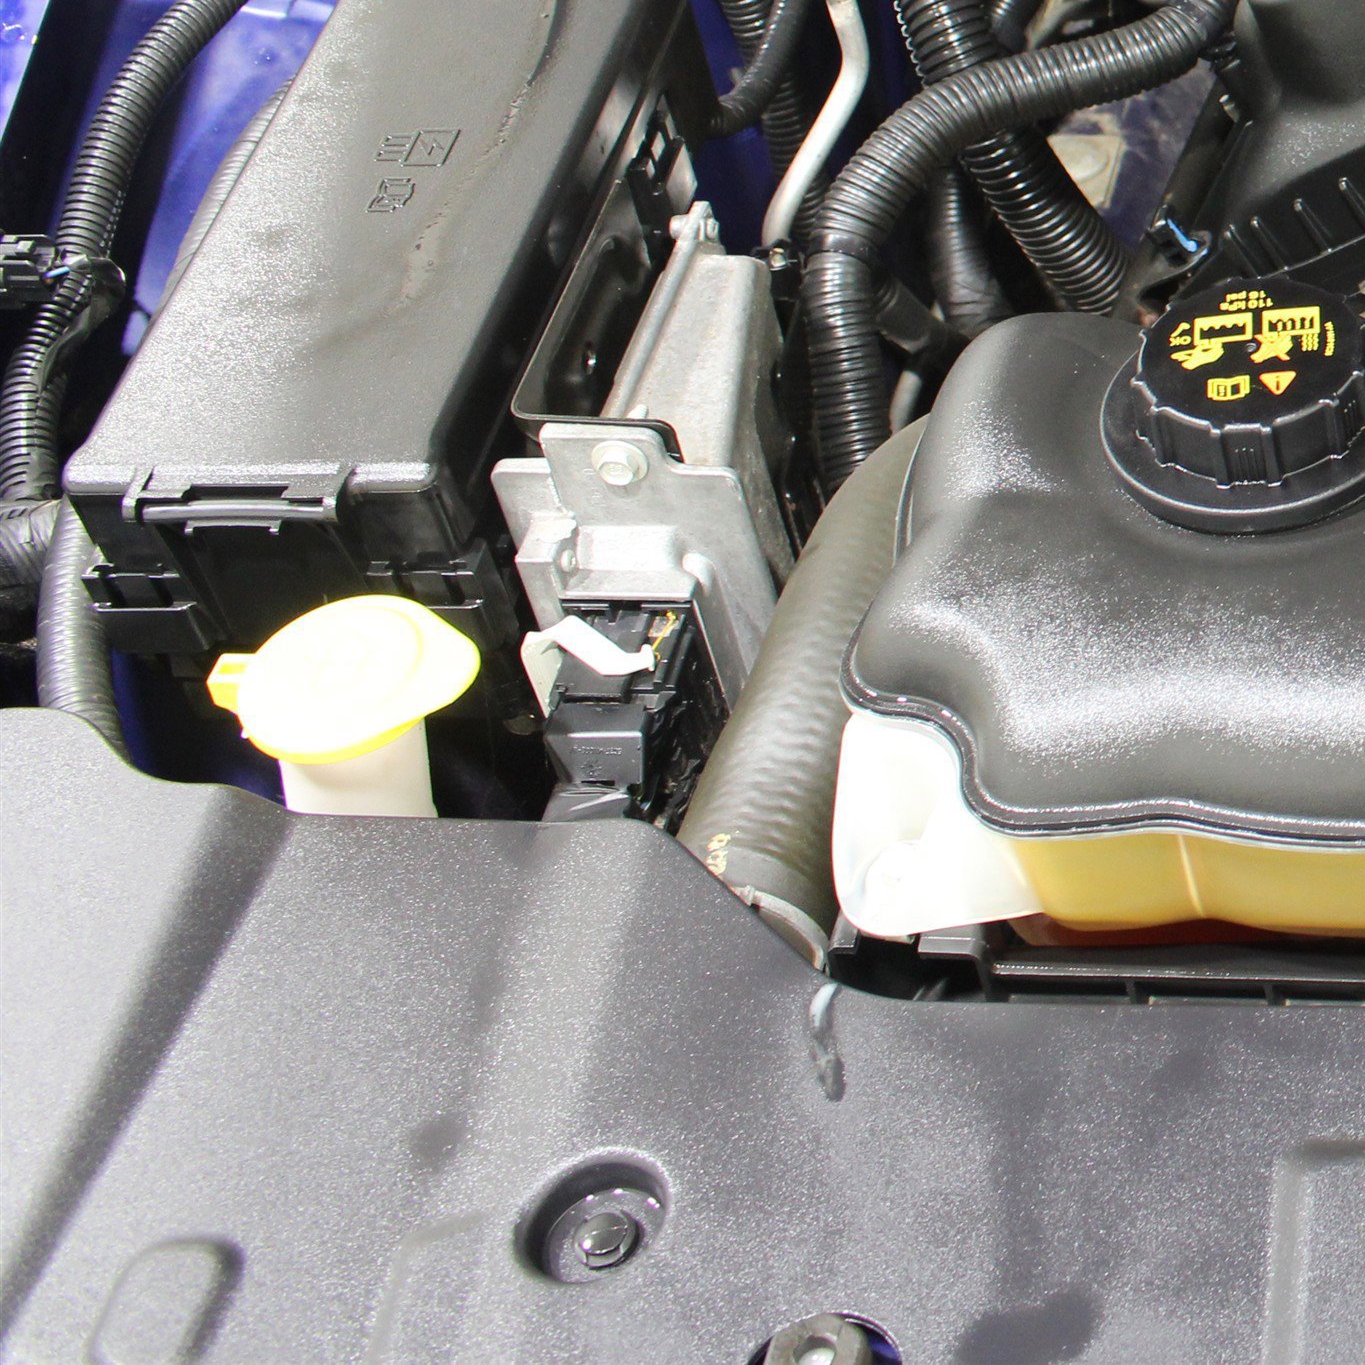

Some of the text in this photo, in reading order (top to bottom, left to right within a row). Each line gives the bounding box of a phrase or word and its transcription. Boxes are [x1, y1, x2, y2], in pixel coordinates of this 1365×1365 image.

[1225, 289, 1267, 301] 16 psi
[1219, 297, 1274, 312] 110 kPa
[1169, 335, 1192, 346] OK
